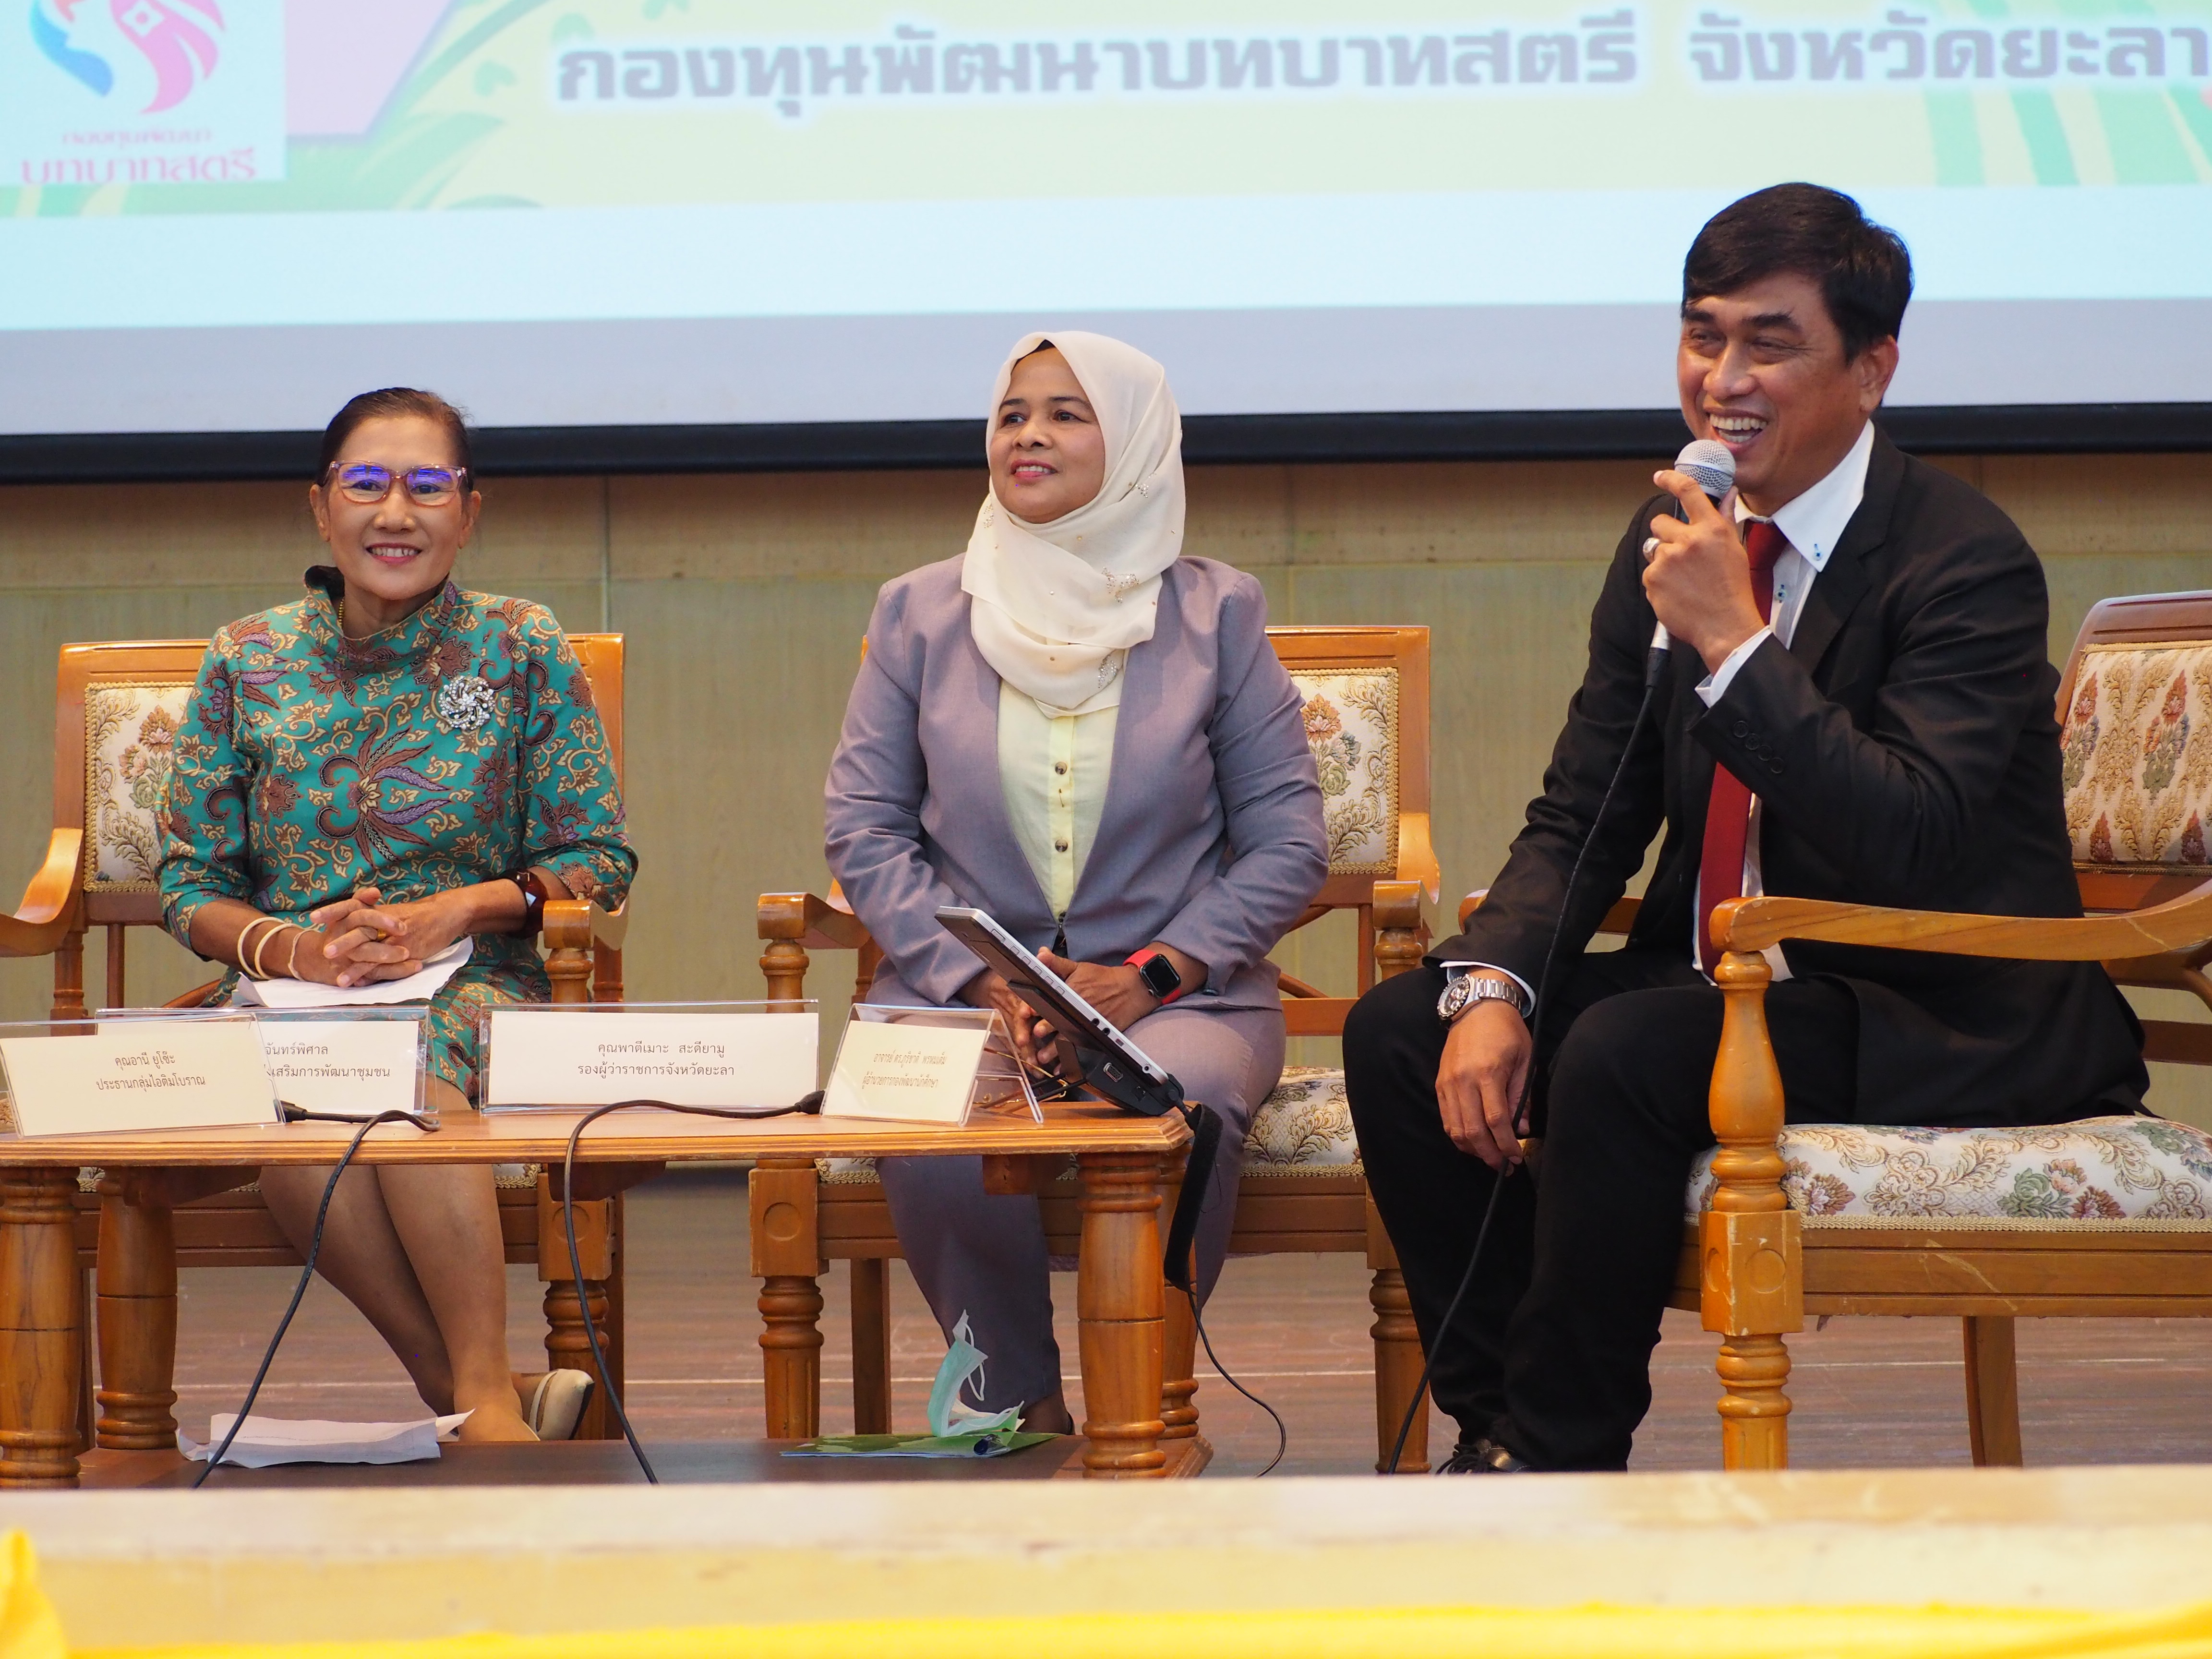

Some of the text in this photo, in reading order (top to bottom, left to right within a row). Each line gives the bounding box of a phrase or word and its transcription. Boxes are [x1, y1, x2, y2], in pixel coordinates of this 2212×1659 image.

[558, 9, 2208, 117] กองทุนพัฒนาบทบาทสตรี จังหวัดยะลา
[598, 1040, 724, 1058] คุณพาตีเมาะ สะดียามู
[115, 1051, 150, 1071] คุณอานี
[577, 1061, 734, 1079] รองผู้ว่าราชการจังหวัดยะลา
[96, 1072, 206, 1092] ประธานกลุ่มไอติมโบราณ
